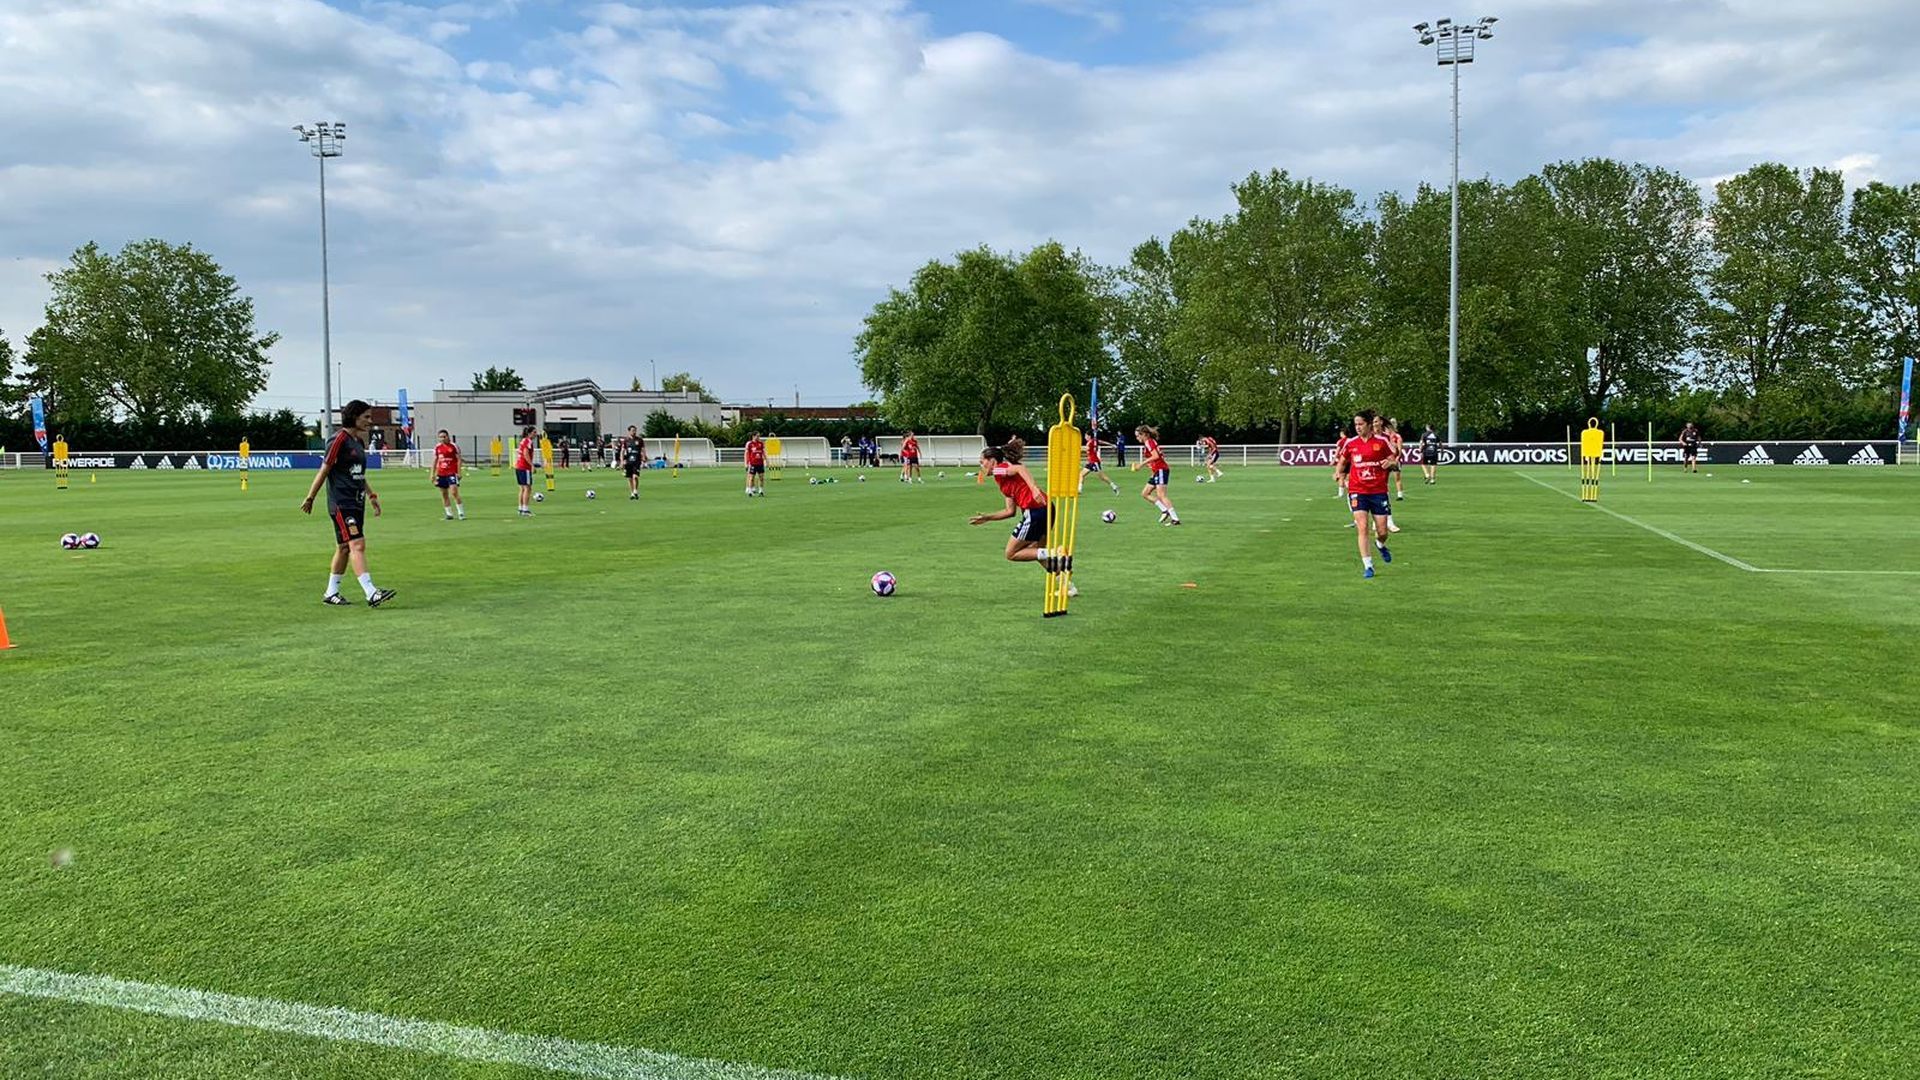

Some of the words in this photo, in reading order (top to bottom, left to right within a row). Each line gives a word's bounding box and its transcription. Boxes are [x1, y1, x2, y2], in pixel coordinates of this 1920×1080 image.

[1459, 449, 1489, 463] KIA
[1493, 448, 1568, 463] MOTORS
[1588, 448, 1709, 462] OWERAE
[52, 457, 115, 467] POWERADE
[247, 456, 292, 468] WANDA
[1738, 458, 1775, 466] adidas
[1792, 458, 1830, 466] adidas
[1847, 458, 1885, 466] adidas
